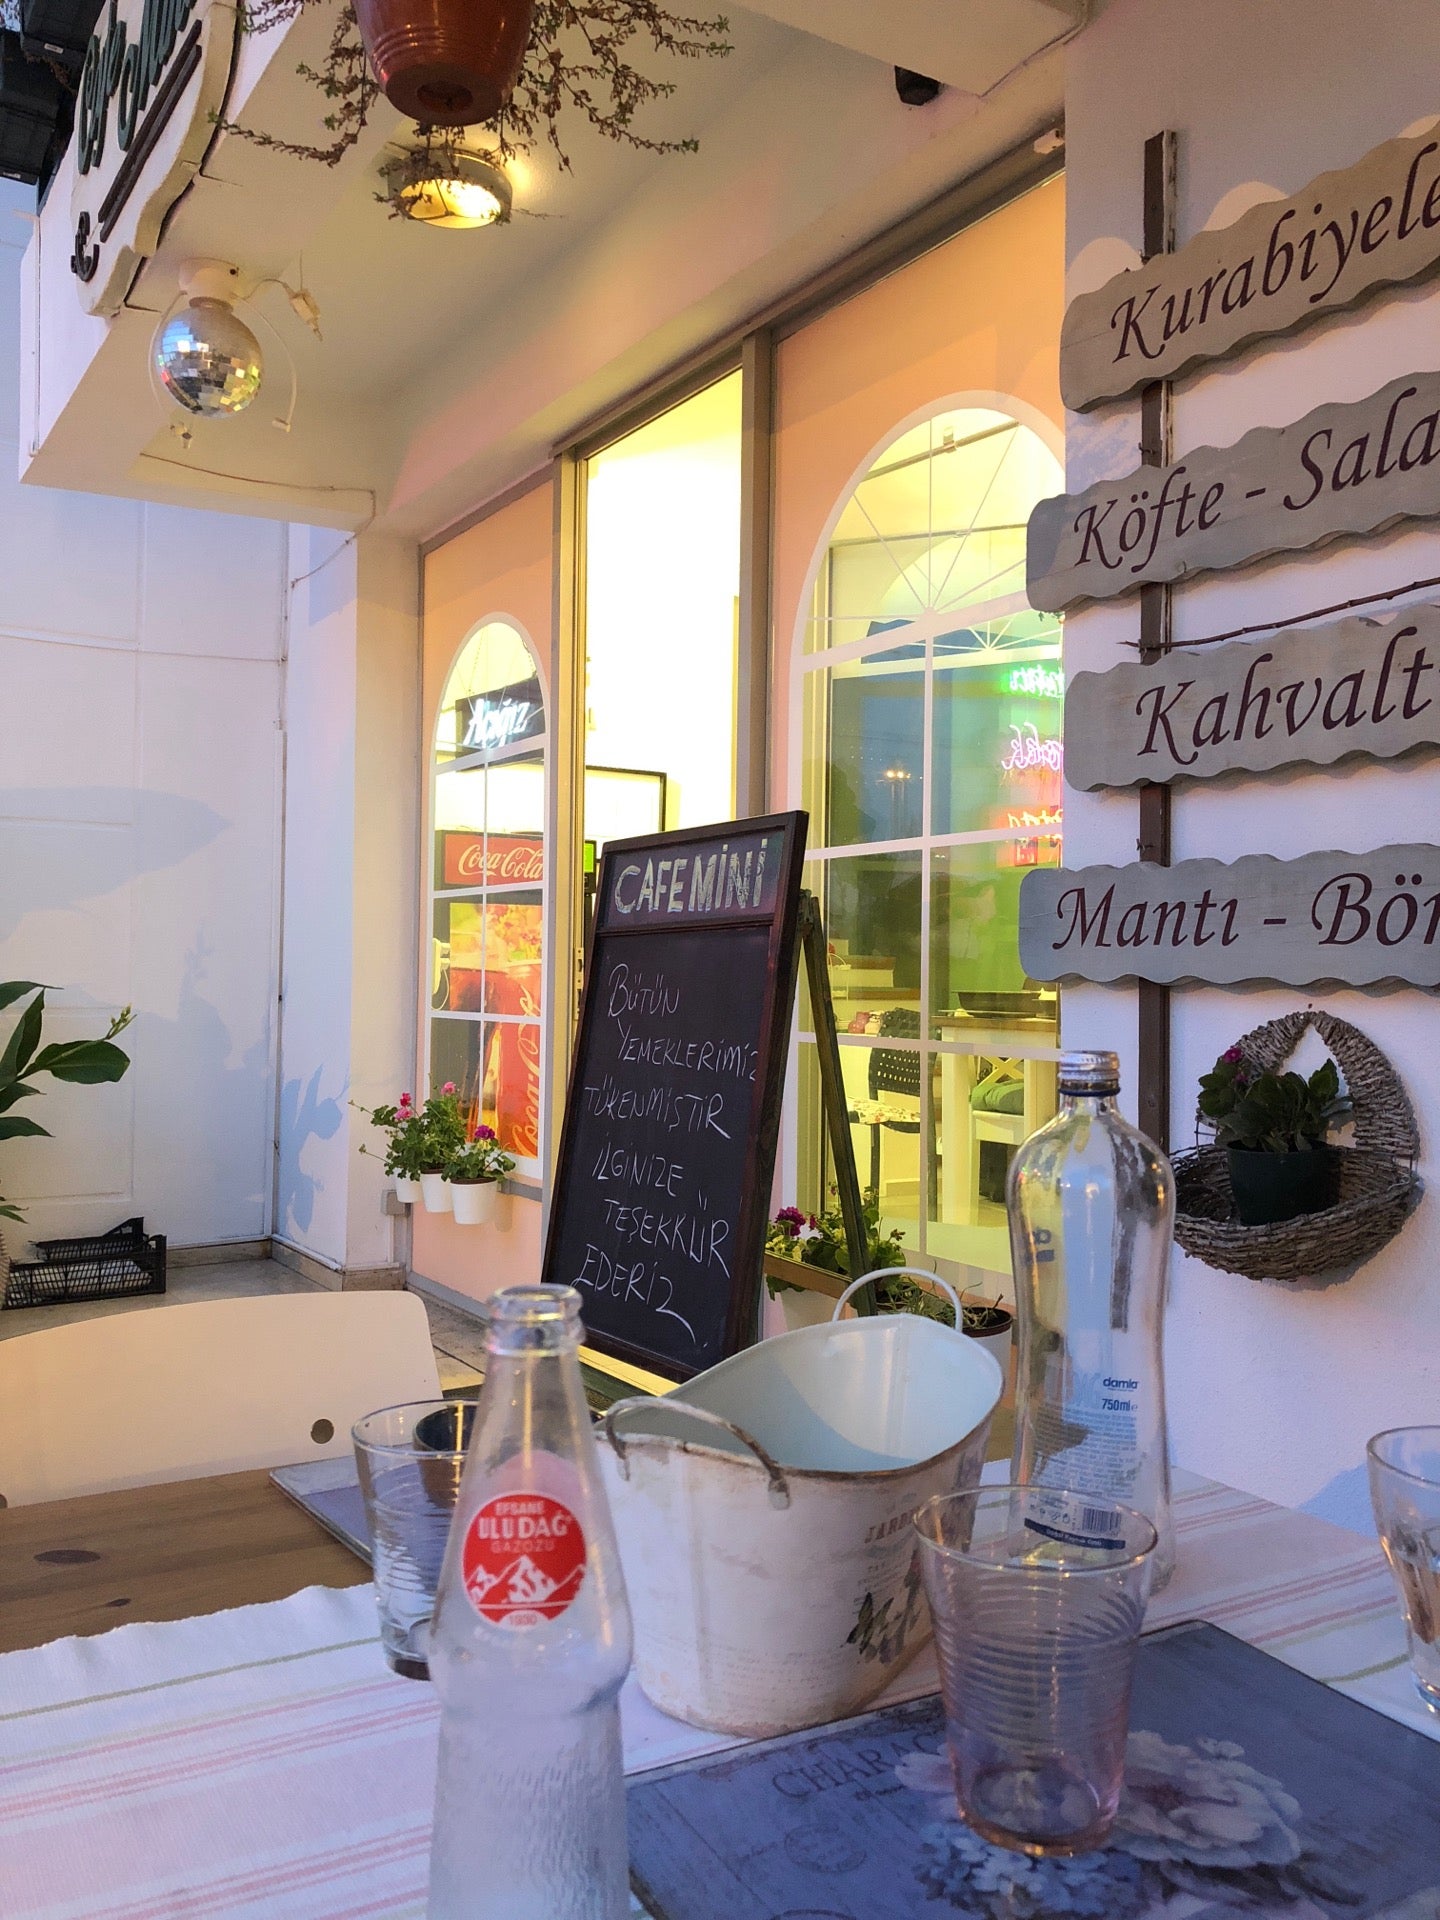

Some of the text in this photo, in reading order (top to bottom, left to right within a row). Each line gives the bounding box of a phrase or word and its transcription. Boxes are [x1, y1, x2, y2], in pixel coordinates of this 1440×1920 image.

[1073, 466, 1225, 573] Köfte
[1282, 386, 1440, 511] Sala
[1135, 626, 1440, 766] Kahvalt
[614, 857, 689, 914] CAFE
[1051, 882, 1239, 951] Mantı
[608, 963, 680, 1018] BÜTÜN
[604, 1188, 731, 1280] TEŞEKKÜR
[1102, 1398, 1131, 1412] 750ml
[1103, 1376, 1139, 1389] damla
[478, 1510, 568, 1539] ULUDAĞ
